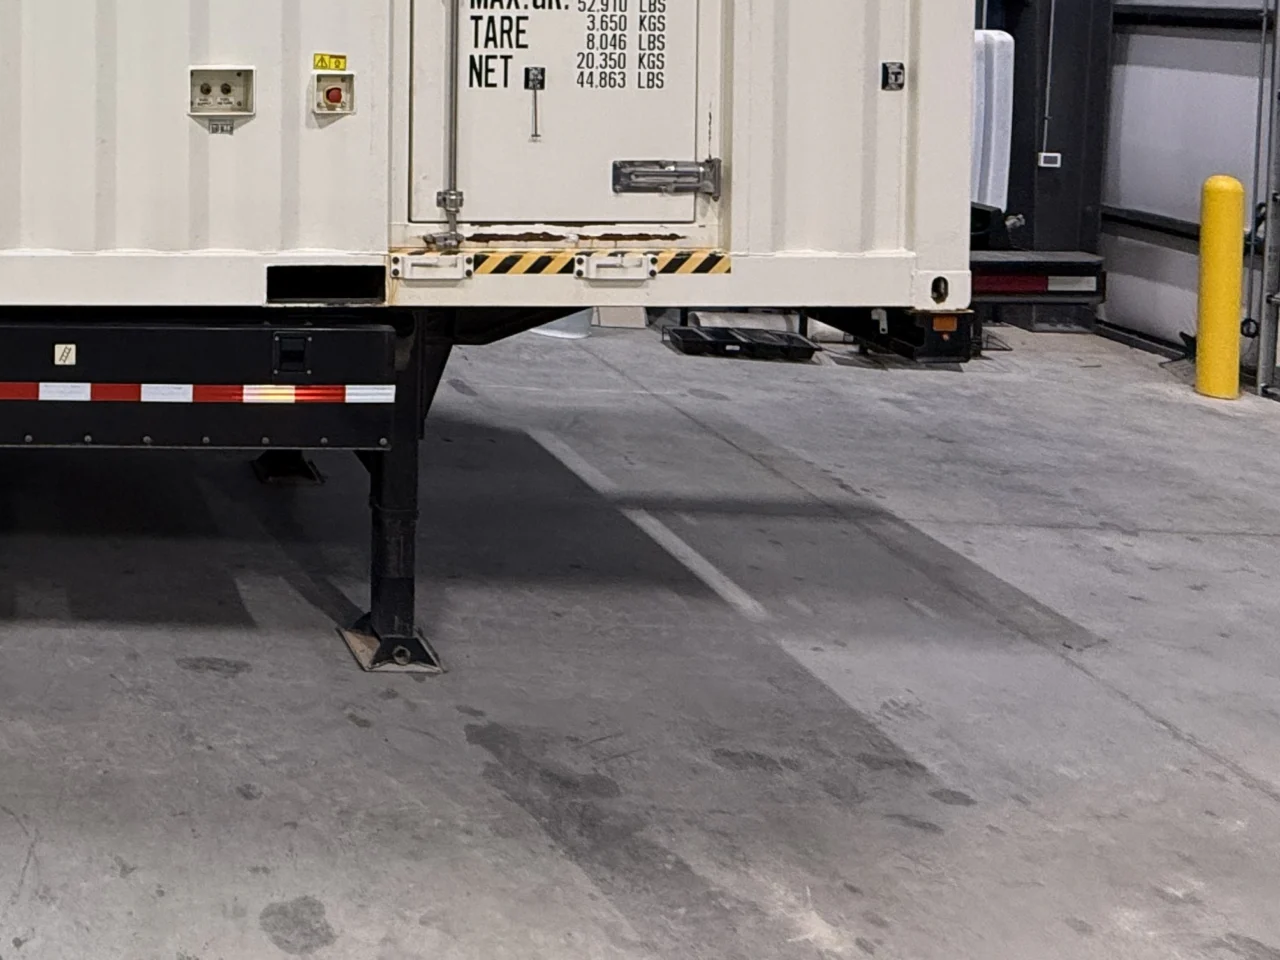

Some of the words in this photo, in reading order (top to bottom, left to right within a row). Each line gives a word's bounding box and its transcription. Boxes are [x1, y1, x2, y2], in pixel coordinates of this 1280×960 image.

[470, 15, 529, 49] TARE
[586, 14, 627, 32] 3.650
[638, 14, 666, 32] KGS
[586, 33, 627, 51] 8.046
[638, 34, 665, 51] LBS
[469, 55, 513, 88] NET
[576, 52, 626, 70] 20.350
[638, 52, 665, 70] KGS
[576, 71, 626, 88] 44.863
[637, 71, 664, 89] LBS
